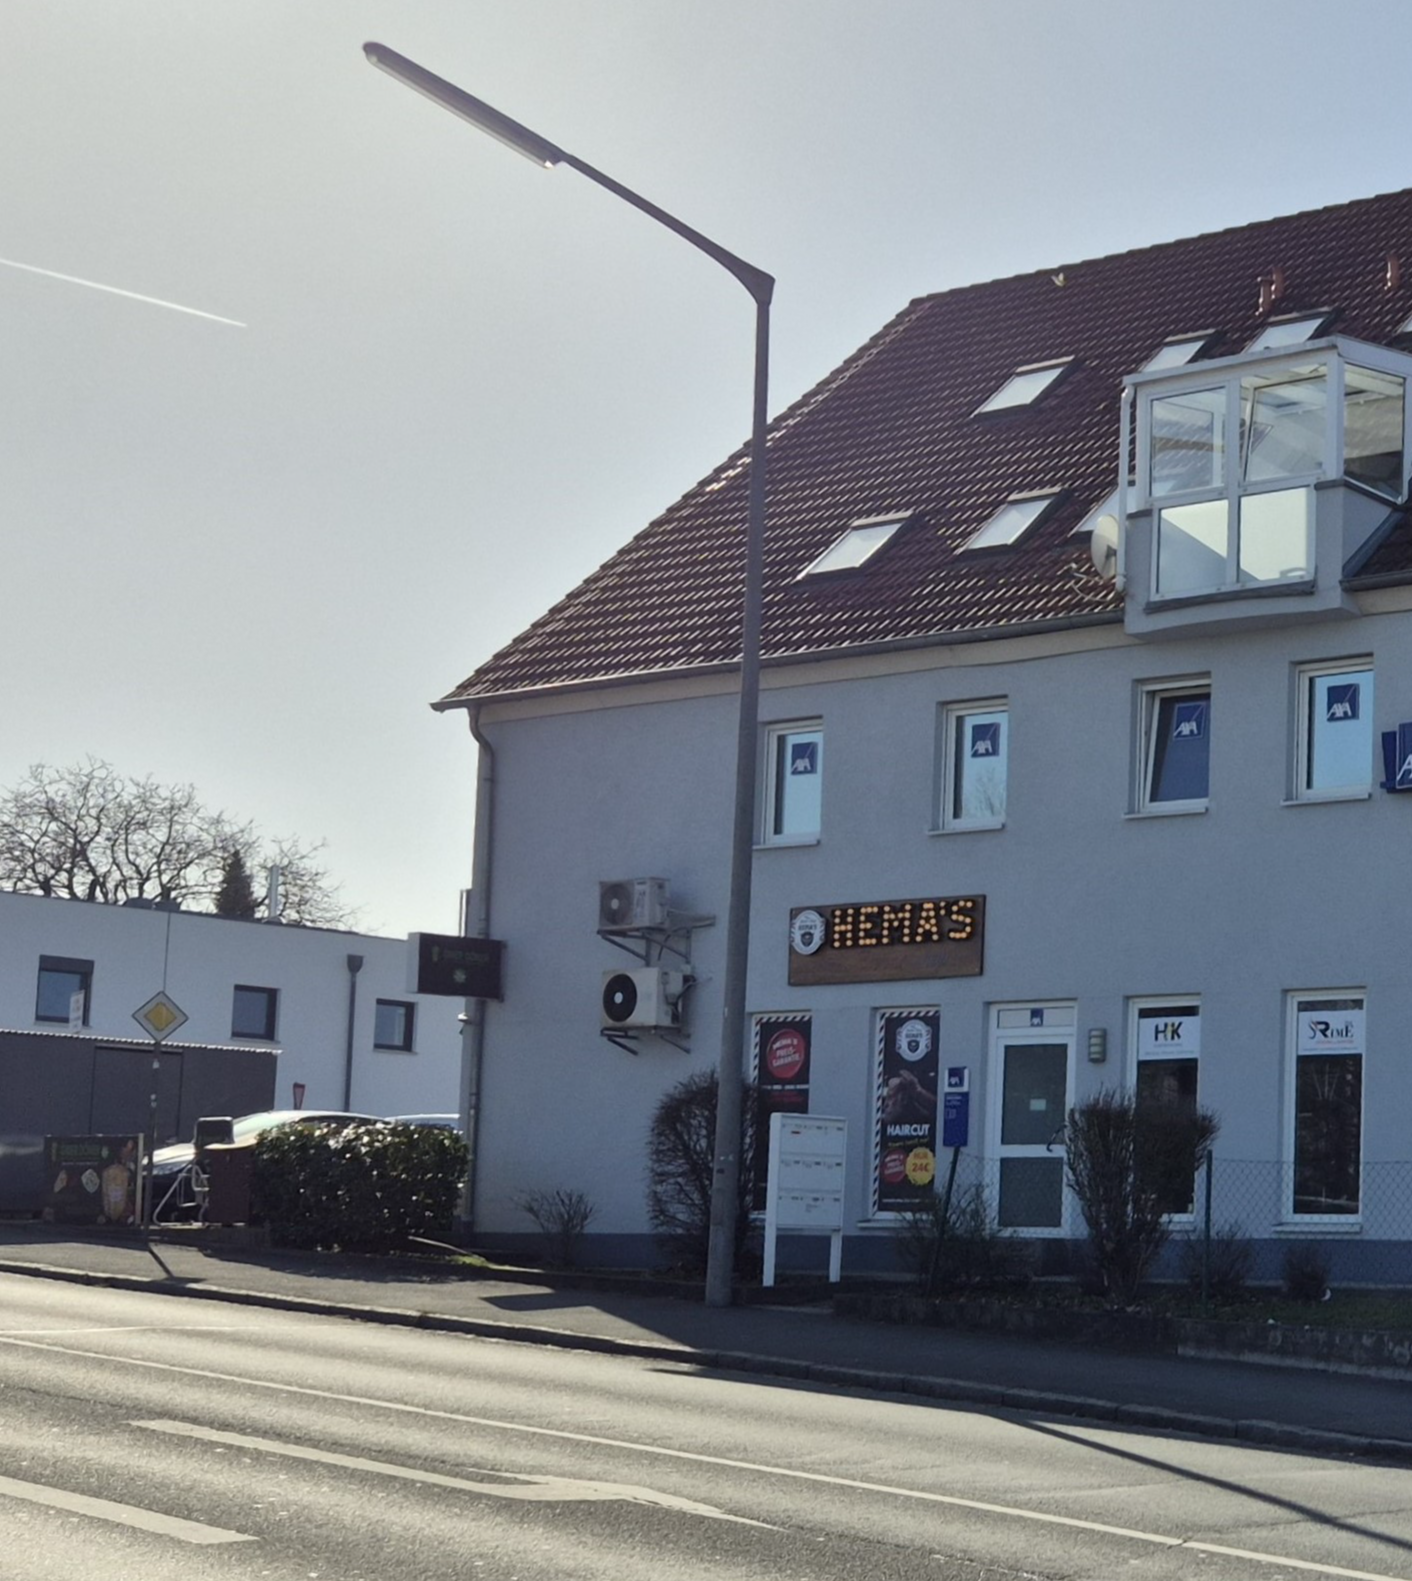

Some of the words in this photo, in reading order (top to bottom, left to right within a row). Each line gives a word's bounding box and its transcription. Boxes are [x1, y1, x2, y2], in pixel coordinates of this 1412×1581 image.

[1327, 702, 1353, 720] AXA
[1173, 719, 1199, 737] AXA
[972, 740, 993, 755] AXA
[791, 757, 812, 772] AXA
[830, 897, 977, 949] HEMA'S
[886, 1123, 931, 1136] HAIRCUT
